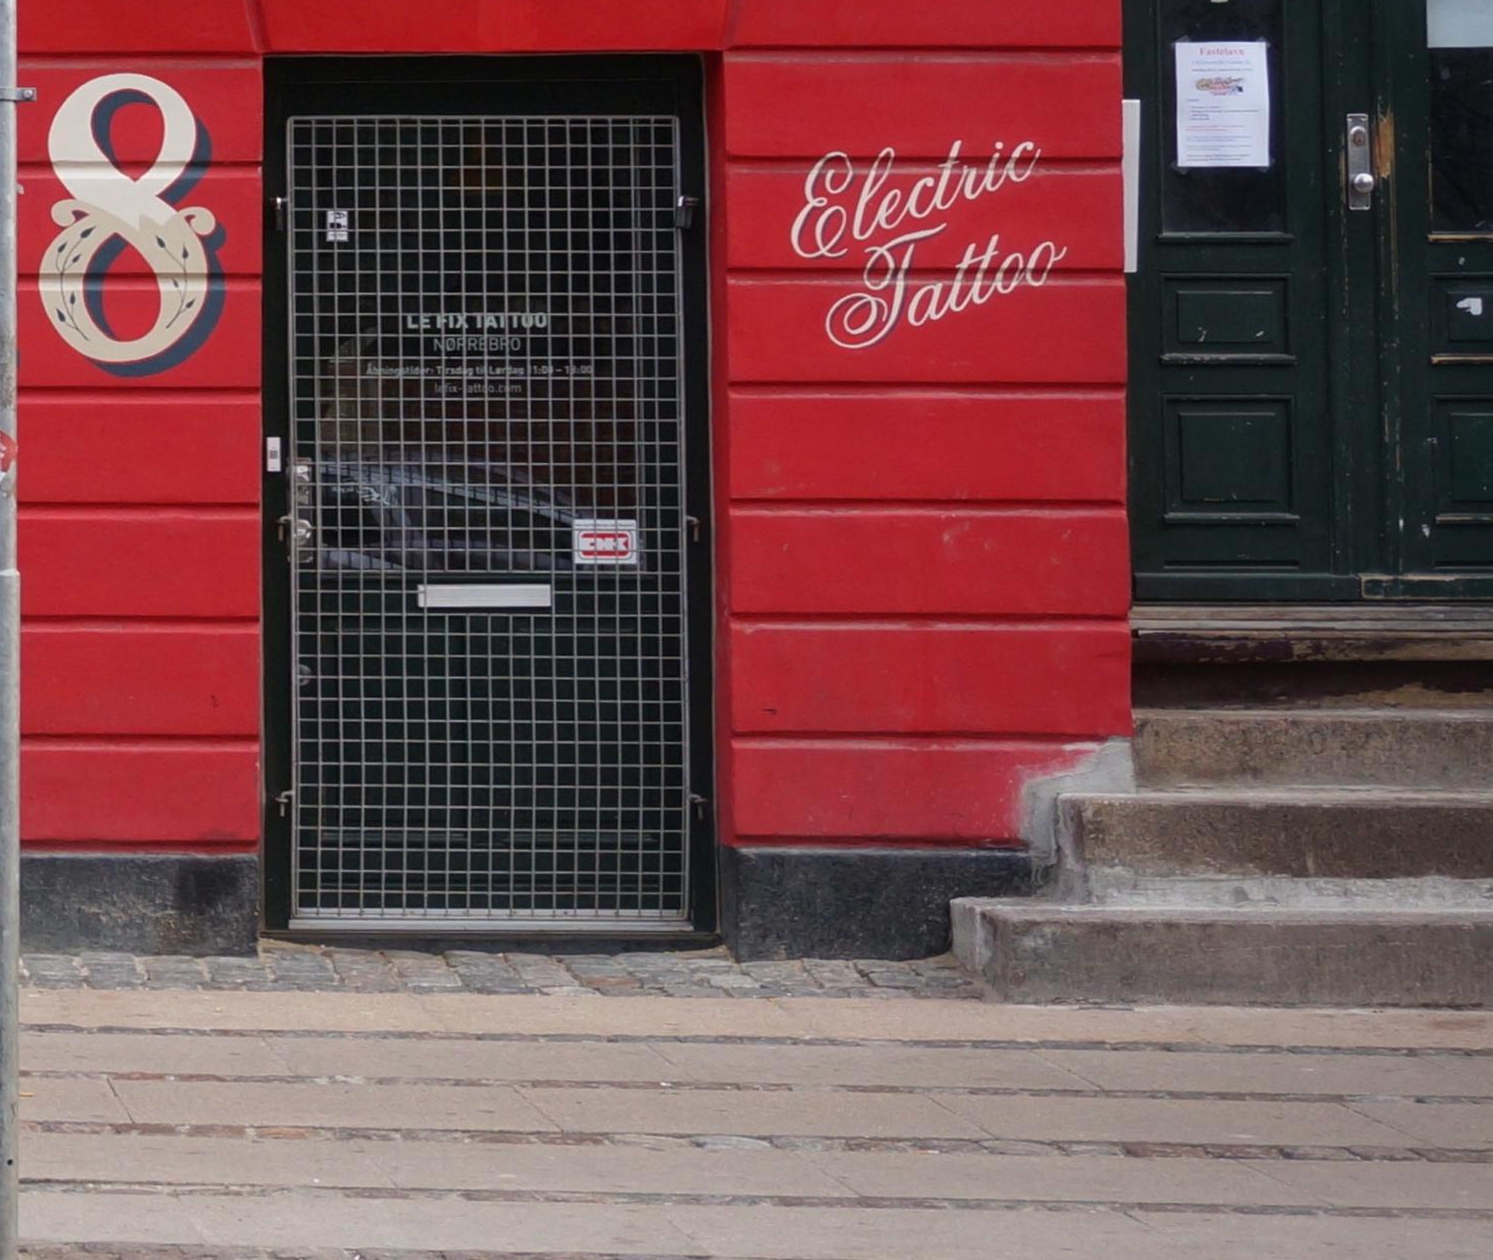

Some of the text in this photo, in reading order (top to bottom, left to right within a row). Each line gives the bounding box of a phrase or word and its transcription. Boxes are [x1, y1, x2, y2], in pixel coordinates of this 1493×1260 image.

[790, 139, 1041, 260] Electric
[825, 223, 1068, 349] Tattoo
[407, 312, 548, 328] LE FIX TATTOO
[433, 337, 521, 351] NØRREBRO
[434, 382, 522, 394] lefix-attoo.com
